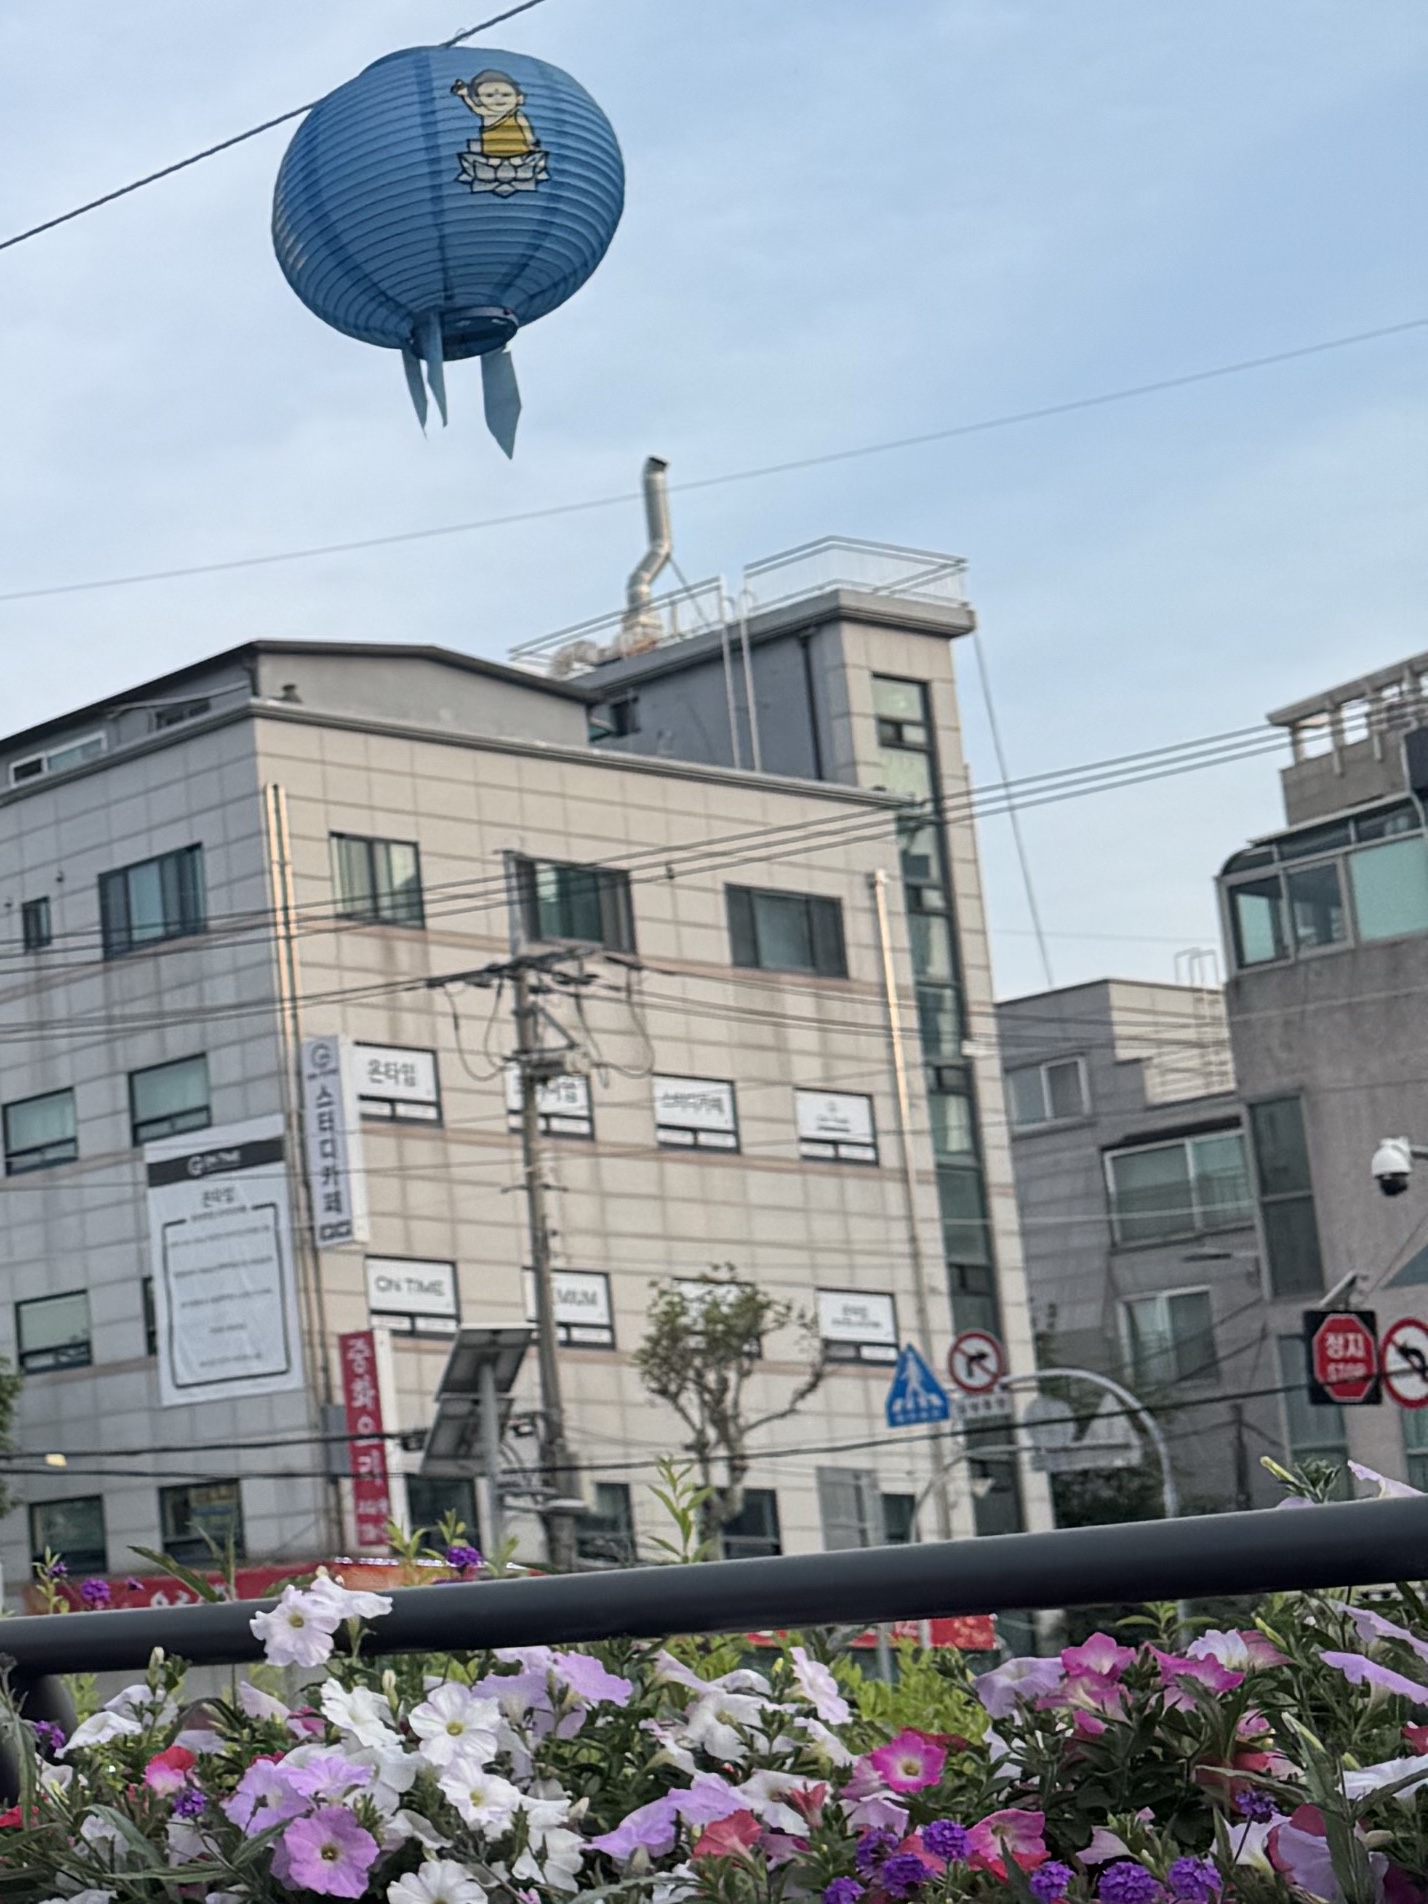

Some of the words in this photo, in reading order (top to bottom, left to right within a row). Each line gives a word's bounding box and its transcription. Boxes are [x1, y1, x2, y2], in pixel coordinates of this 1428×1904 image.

[367, 1058, 418, 1089] 온타임
[316, 1084, 343, 1214] 스터디카페
[374, 1275, 401, 1293] ON
[404, 1277, 446, 1297] TIME
[1325, 1333, 1366, 1360] 정지
[347, 1337, 382, 1488] 중화요리
